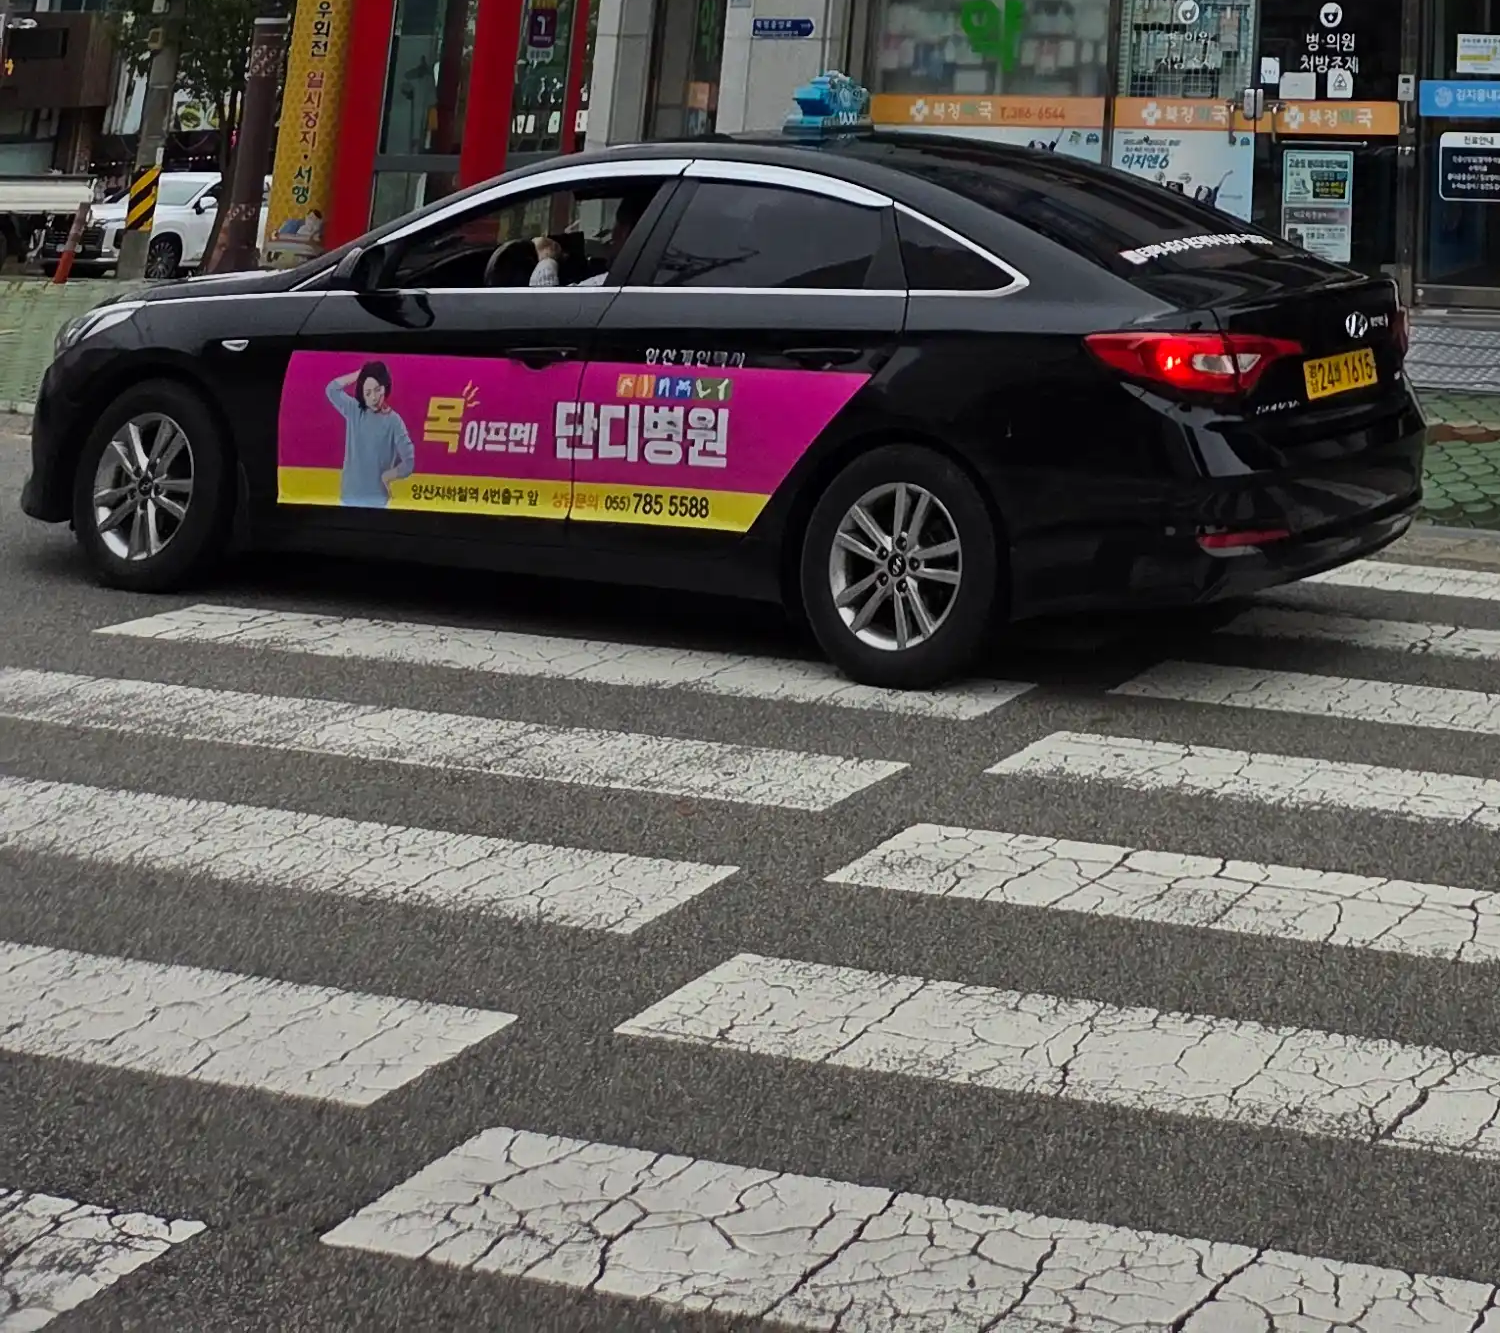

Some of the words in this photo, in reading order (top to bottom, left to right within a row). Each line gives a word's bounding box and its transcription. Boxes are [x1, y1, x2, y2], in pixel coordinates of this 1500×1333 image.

[311, 0, 333, 58] 우회전
[300, 71, 325, 150] 일시정지
[1121, 152, 1170, 171] 이지엔6
[292, 165, 312, 205] 서행
[1343, 352, 1374, 384] 1615
[423, 397, 466, 454] 목
[465, 420, 539, 455] 아프면!
[555, 401, 730, 469] 단디병원
[527, 489, 539, 507] 앞
[633, 492, 663, 516] 785
[668, 495, 710, 519] 5588
